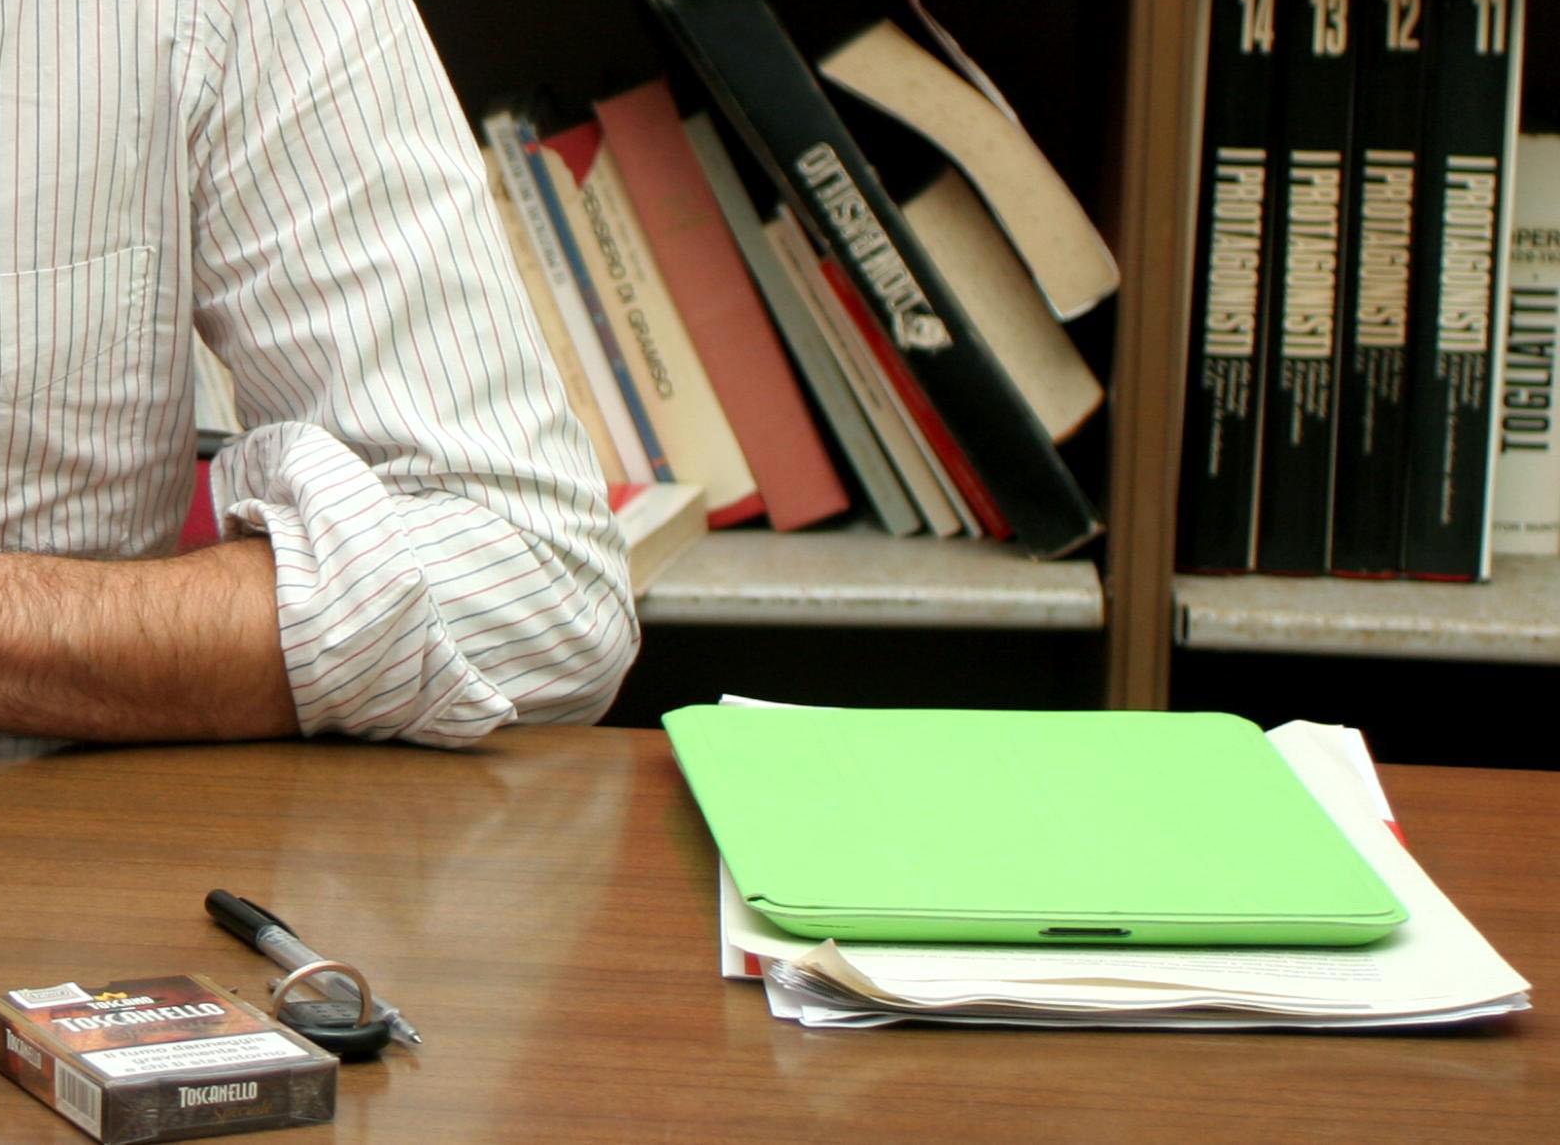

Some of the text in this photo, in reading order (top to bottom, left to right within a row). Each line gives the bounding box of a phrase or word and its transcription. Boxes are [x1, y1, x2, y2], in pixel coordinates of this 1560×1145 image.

[1216, 147, 1267, 161] I
[1290, 150, 1341, 164] I
[1364, 149, 1415, 162] I
[1445, 155, 1497, 170] I
[1203, 165, 1266, 354] PROTAGONISTI
[1281, 167, 1341, 358] PROTAGONISTI
[1355, 167, 1414, 346] PROTAGONISTI
[1437, 172, 1496, 352] PROTAGONISTI
[628, 308, 674, 400] GRAMSCI
[1501, 287, 1559, 454] TOGLIATTI
[51, 1002, 226, 1032] TOSCANELLO
[87, 996, 155, 1010] TOSCANO
[179, 1081, 258, 1108] TOSCANELLO
